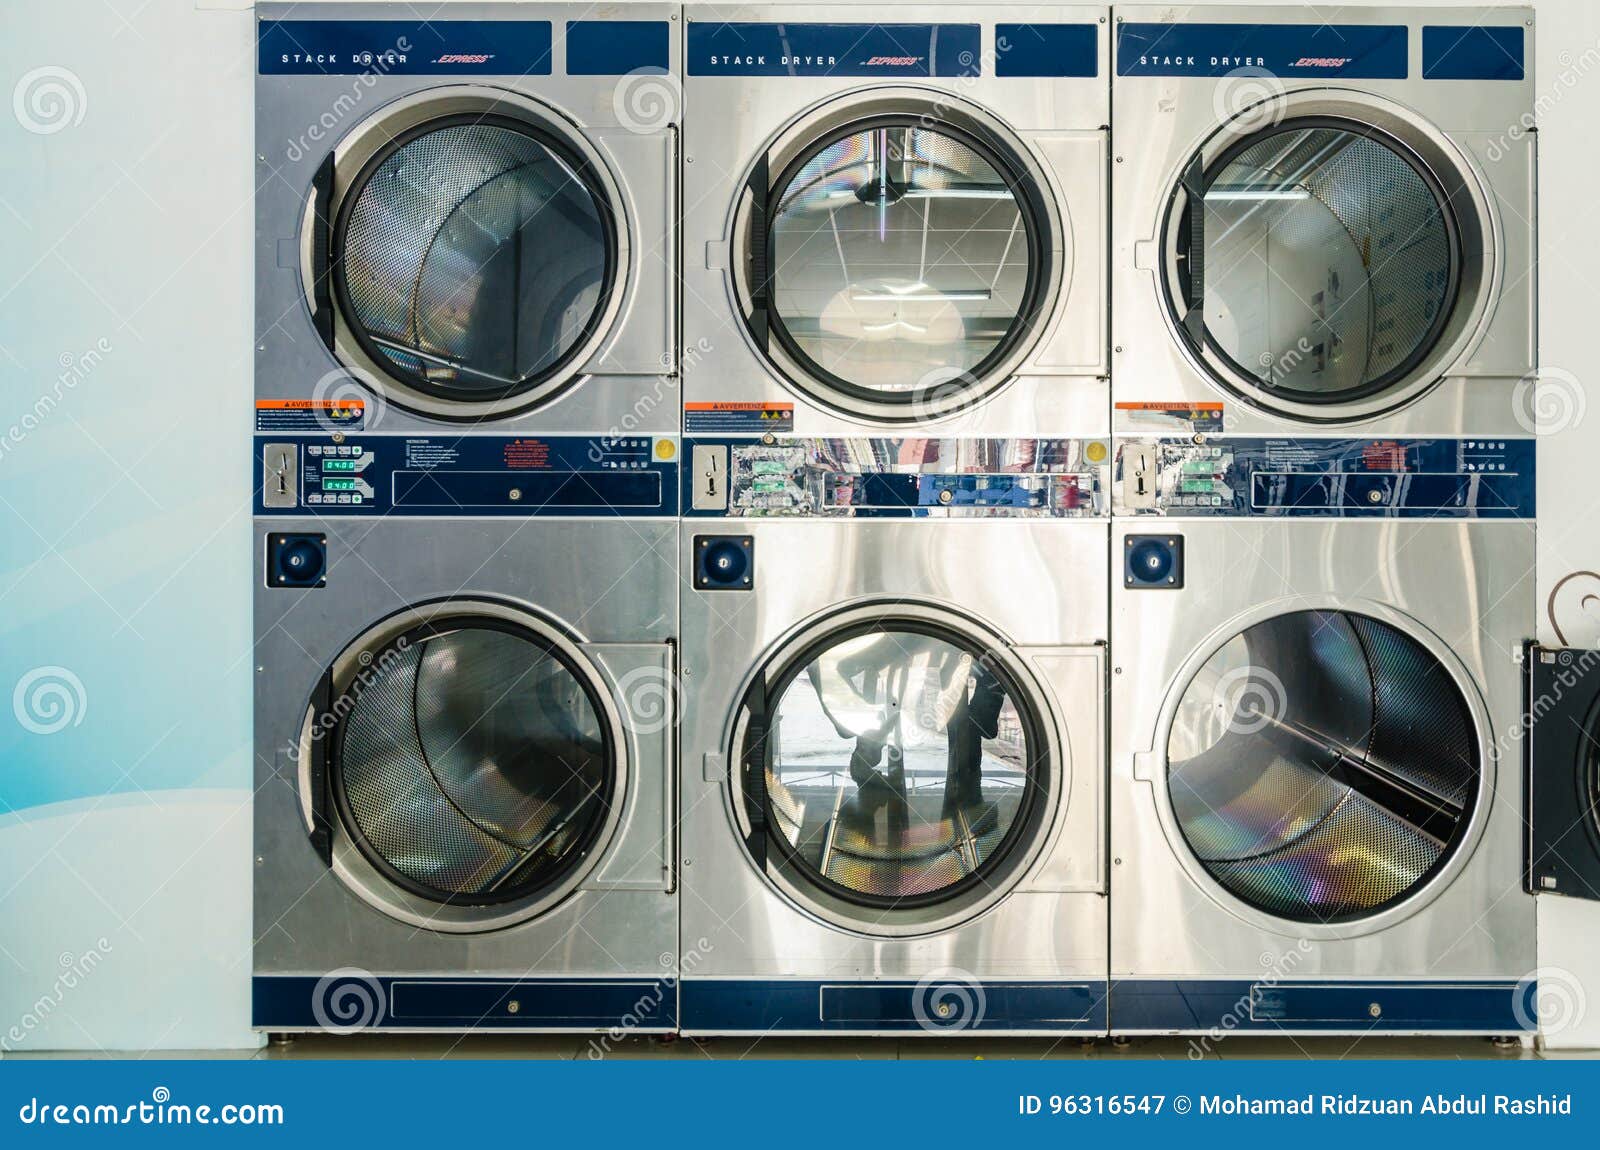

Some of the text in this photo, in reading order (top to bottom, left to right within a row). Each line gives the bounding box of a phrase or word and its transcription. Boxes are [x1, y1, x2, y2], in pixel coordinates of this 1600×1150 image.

[281, 54, 407, 63] STACK DRYER
[438, 54, 488, 63] EXPRESS
[711, 56, 835, 65] STACK DRYER
[866, 56, 917, 65] EXPRESS
[1140, 56, 1265, 66] STACK DRYER
[1295, 58, 1345, 67] EXPRESS
